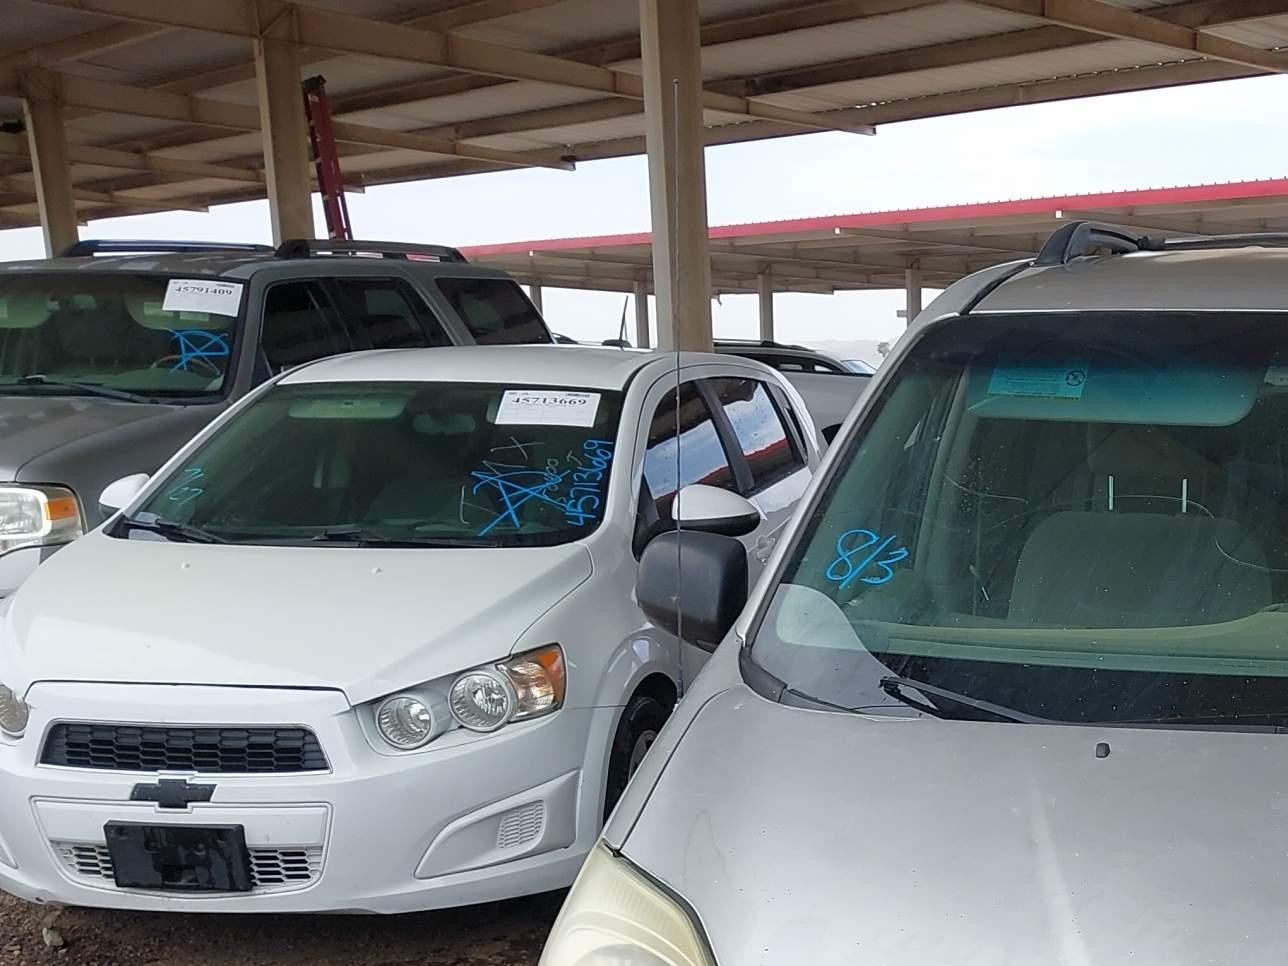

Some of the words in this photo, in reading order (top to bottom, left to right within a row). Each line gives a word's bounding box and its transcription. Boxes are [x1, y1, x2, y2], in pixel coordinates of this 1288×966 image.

[175, 286, 233, 296] 45791409
[512, 397, 587, 406] 45713669
[825, 529, 909, 590] 8/3
